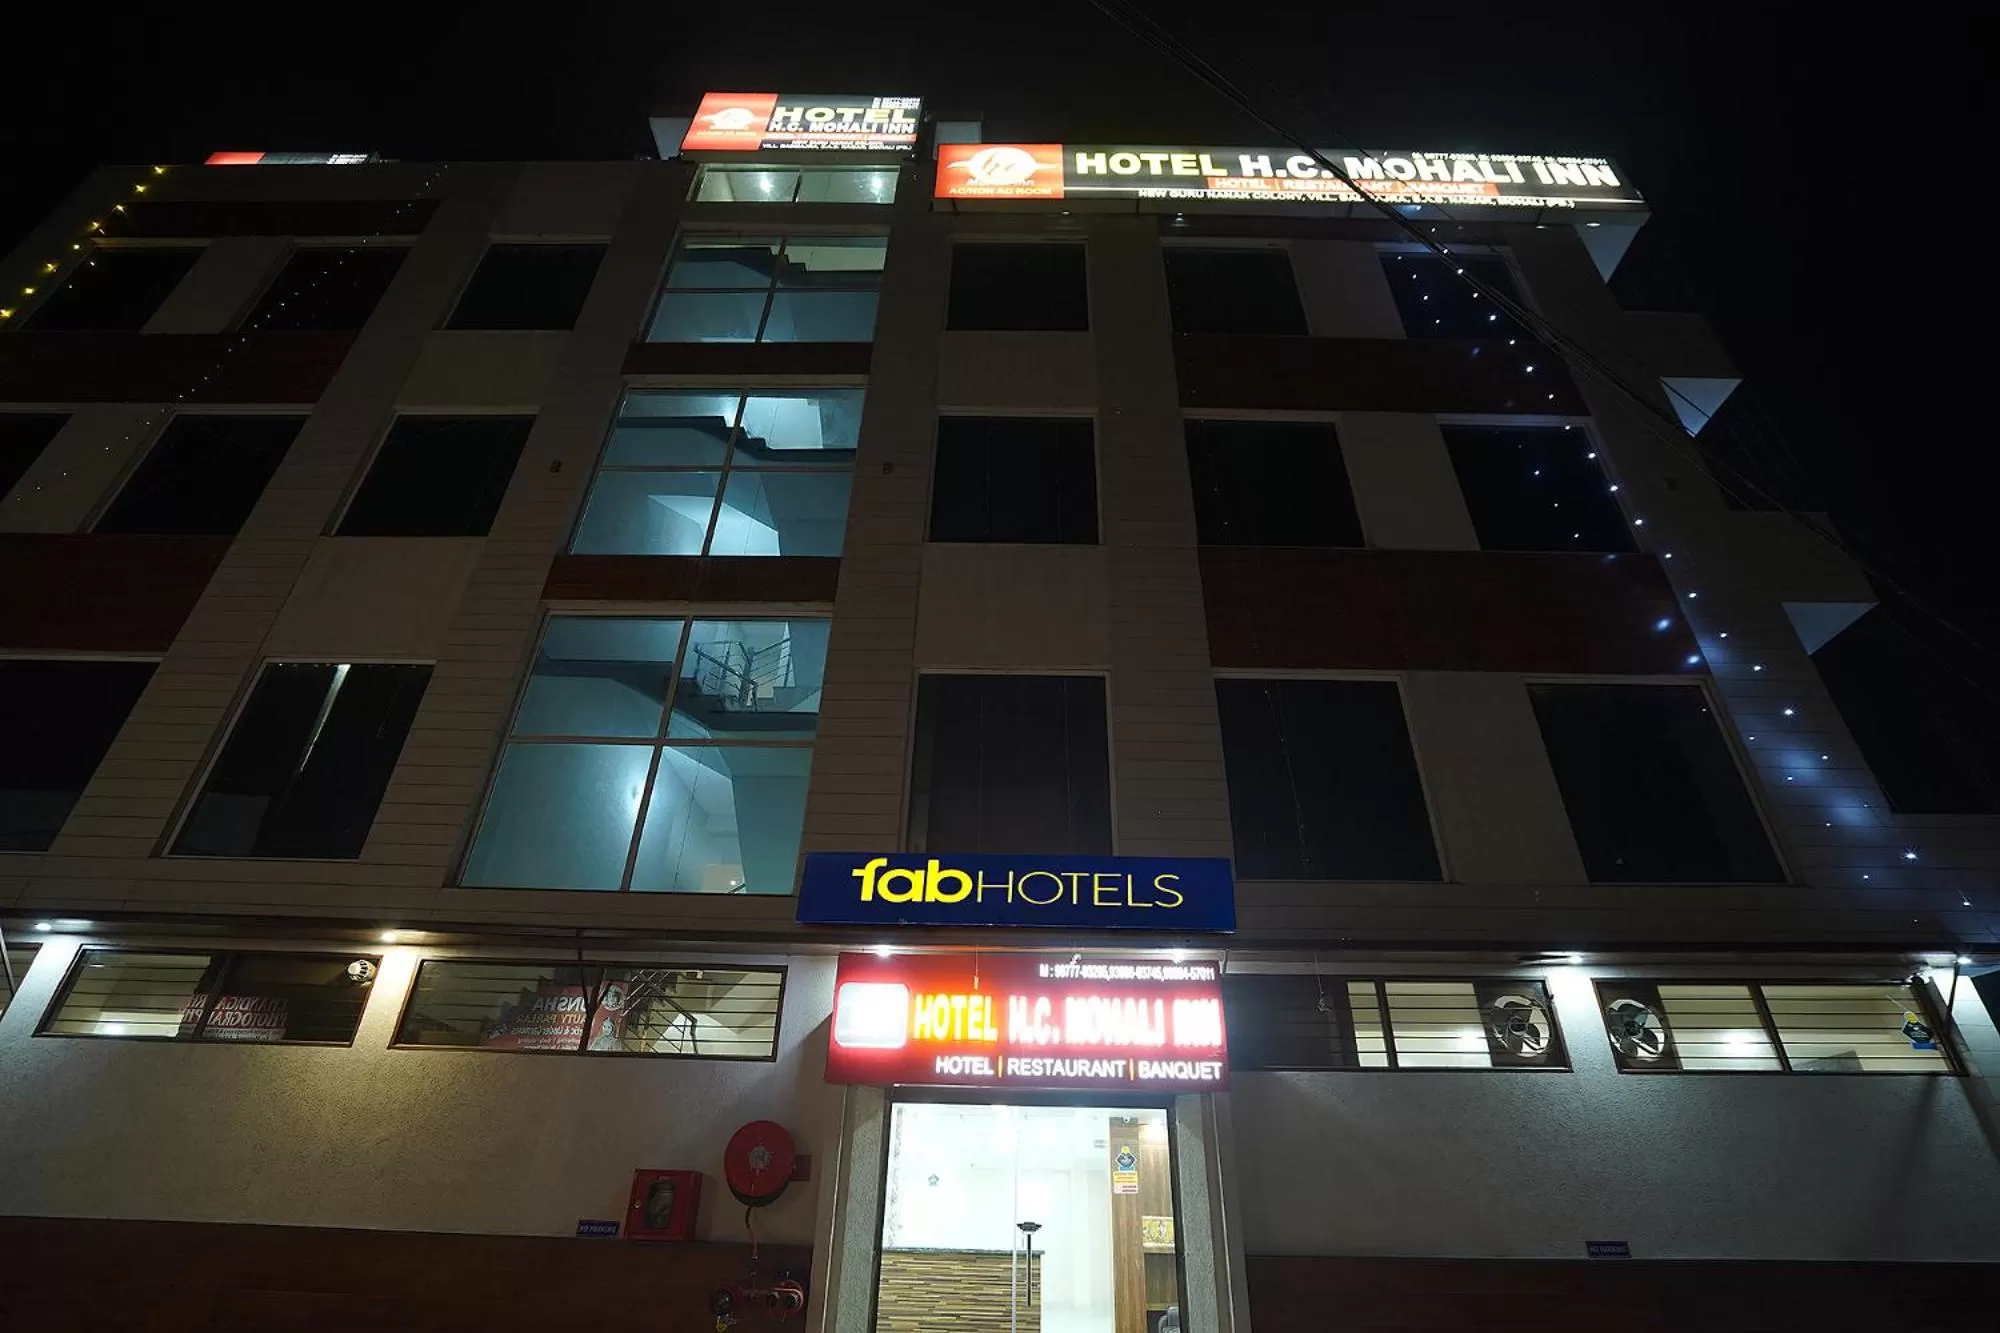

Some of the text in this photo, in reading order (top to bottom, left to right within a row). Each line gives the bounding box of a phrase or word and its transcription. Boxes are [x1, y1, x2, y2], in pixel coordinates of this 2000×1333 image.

[774, 107, 916, 124] HOTEL
[809, 122, 877, 133] MOHALI
[882, 123, 915, 134] INN
[1075, 152, 1227, 176] HOTEL
[1240, 155, 1331, 178] H.C.
[1343, 157, 1525, 183] MOHALI
[1532, 163, 1621, 187] INN
[913, 994, 999, 1042] HOTEL
[1064, 996, 1166, 1046] MOHALI
[935, 1055, 1223, 1081] HOTEL RESTAURANT BANQUET
